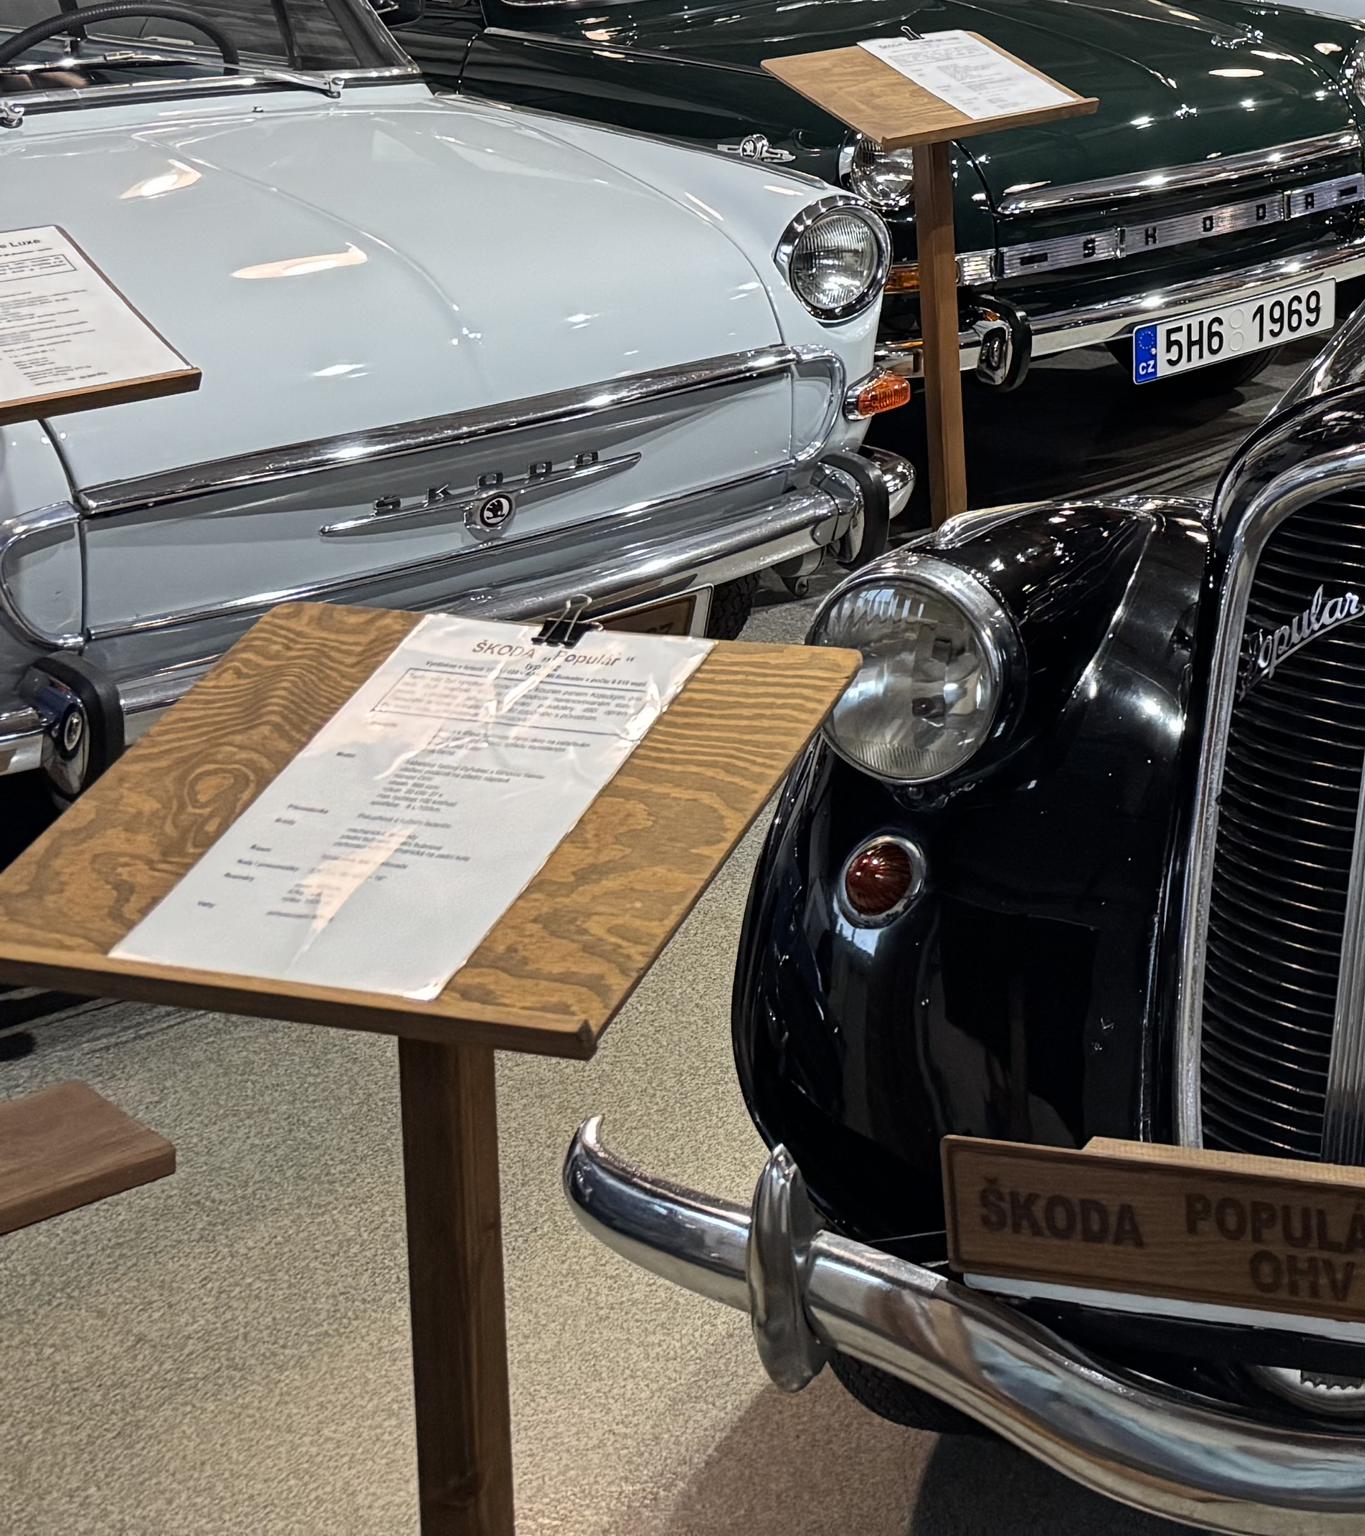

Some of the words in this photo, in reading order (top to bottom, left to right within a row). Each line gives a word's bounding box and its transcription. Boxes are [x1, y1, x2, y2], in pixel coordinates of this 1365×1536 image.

[9, 239, 41, 248] Luxe
[1165, 316, 1224, 366] 5H6
[1252, 290, 1321, 342] 1969
[1138, 360, 1156, 375] CZ
[472, 639, 535, 659] ŠKODA
[978, 1174, 1146, 1249] ŠKODA
[1249, 1248, 1357, 1303] OHV
